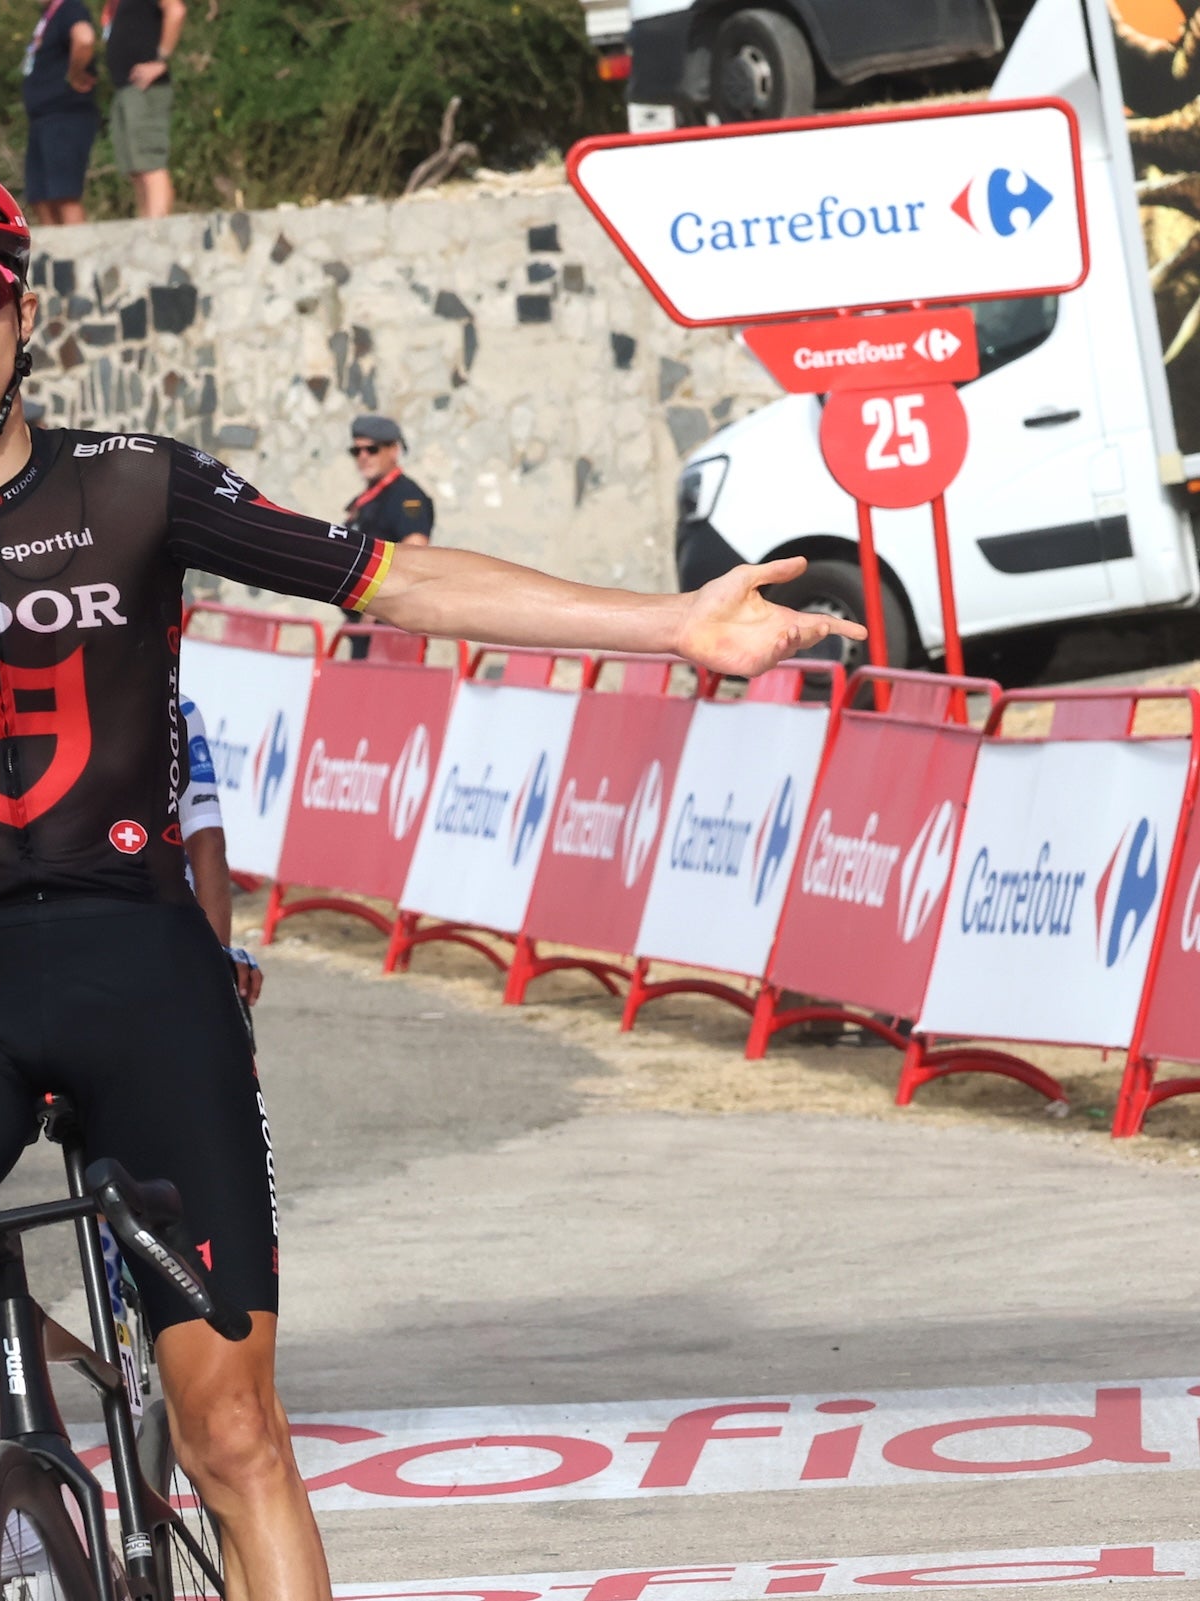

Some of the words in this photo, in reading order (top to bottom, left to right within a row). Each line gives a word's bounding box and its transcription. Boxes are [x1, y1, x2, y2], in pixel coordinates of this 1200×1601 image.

[670, 196, 925, 253] Carrefour
[793, 341, 907, 370] Carrefour
[73, 435, 157, 457] BMC
[861, 394, 930, 471] 25
[3, 467, 37, 500] TUDOR
[1, 527, 93, 562] sportful
[303, 738, 390, 814] Carrefour
[435, 766, 510, 846] Carrefour
[553, 778, 625, 859] Carrefour
[670, 792, 753, 876] Carrefour
[801, 809, 900, 909] Carrefour
[961, 842, 1085, 936] Carrefour
[134, 1230, 200, 1295] SRAM
[2, 1336, 27, 1396] BMC
